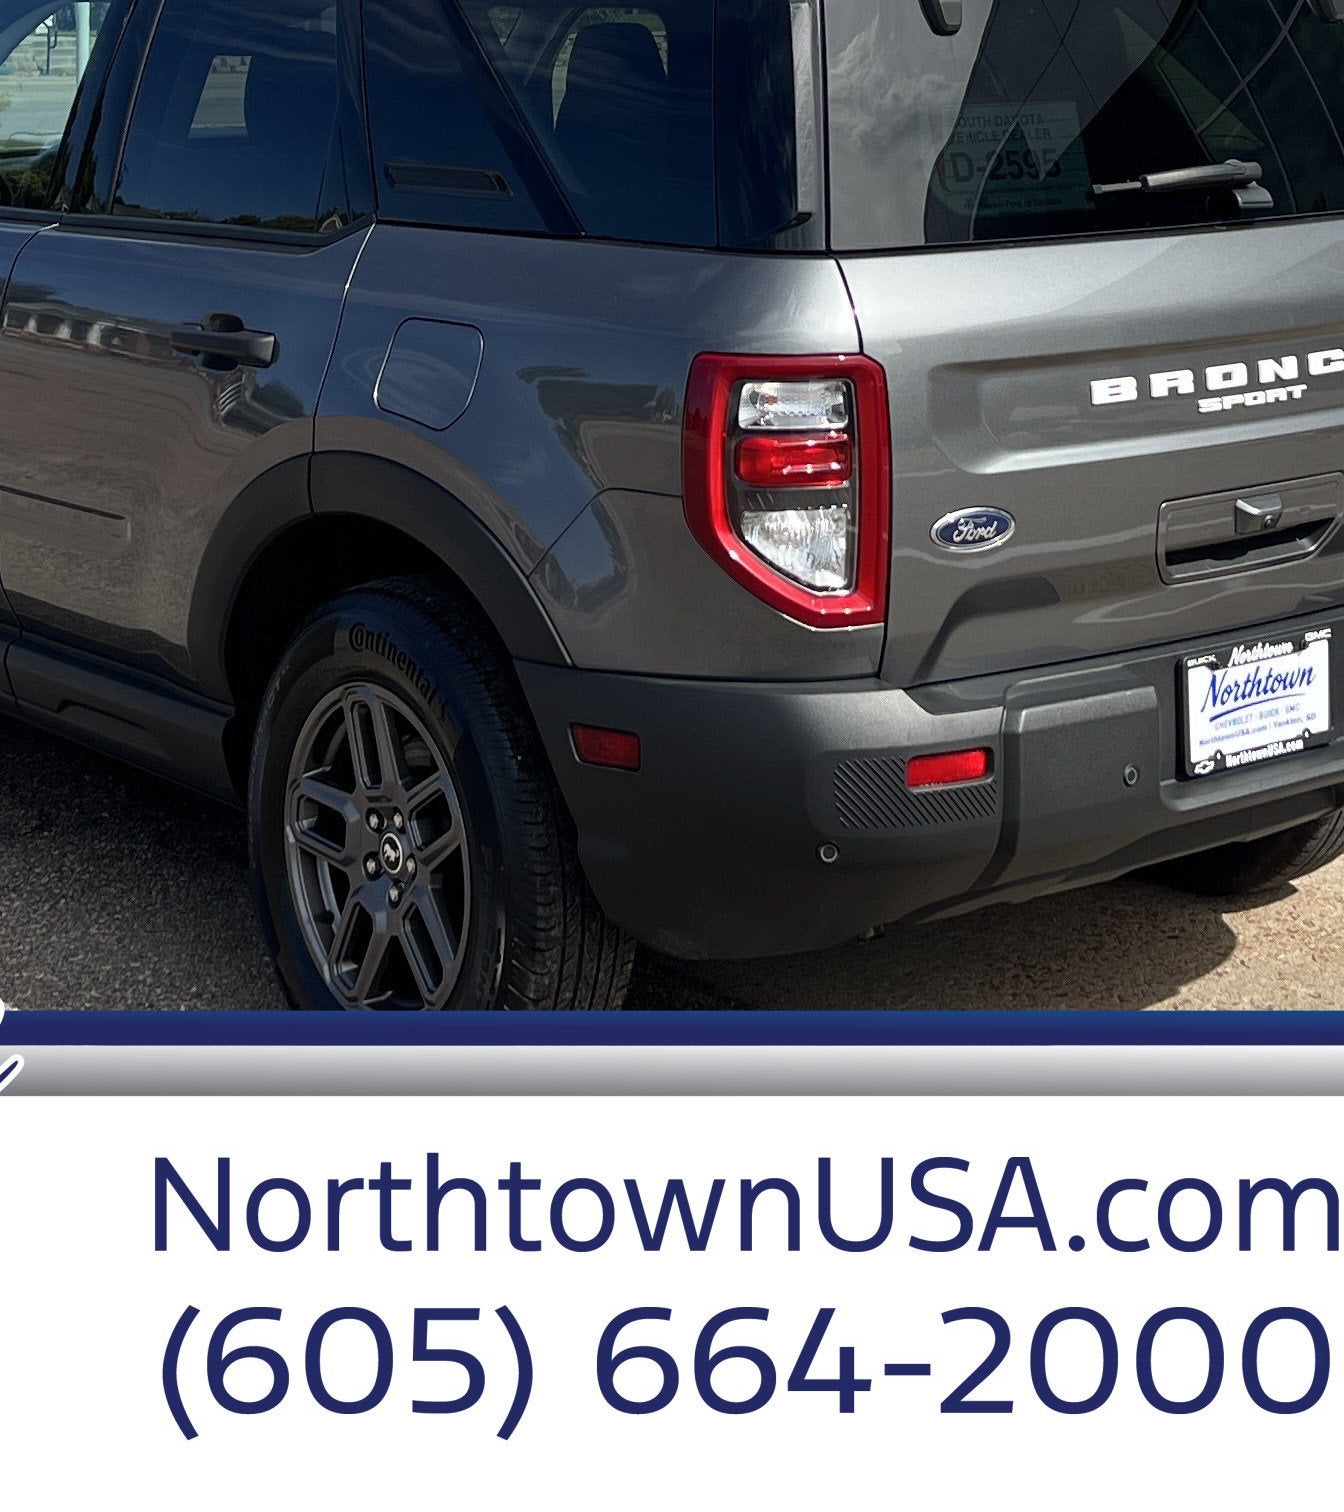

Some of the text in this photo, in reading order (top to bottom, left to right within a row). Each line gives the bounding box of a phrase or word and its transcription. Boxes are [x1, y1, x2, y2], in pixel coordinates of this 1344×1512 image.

[957, 115, 991, 129] OUTH
[1197, 384, 1308, 413] SPORT
[953, 517, 998, 543] Ford
[1304, 628, 1332, 642] GMC
[348, 622, 440, 705] Continental
[1187, 654, 1217, 667] BUICK
[1227, 642, 1294, 668] Northtown
[1200, 665, 1317, 713] Northtown
[1215, 713, 1254, 730] CHEVROLET
[1225, 738, 1304, 768] NorthtownUSA.com
